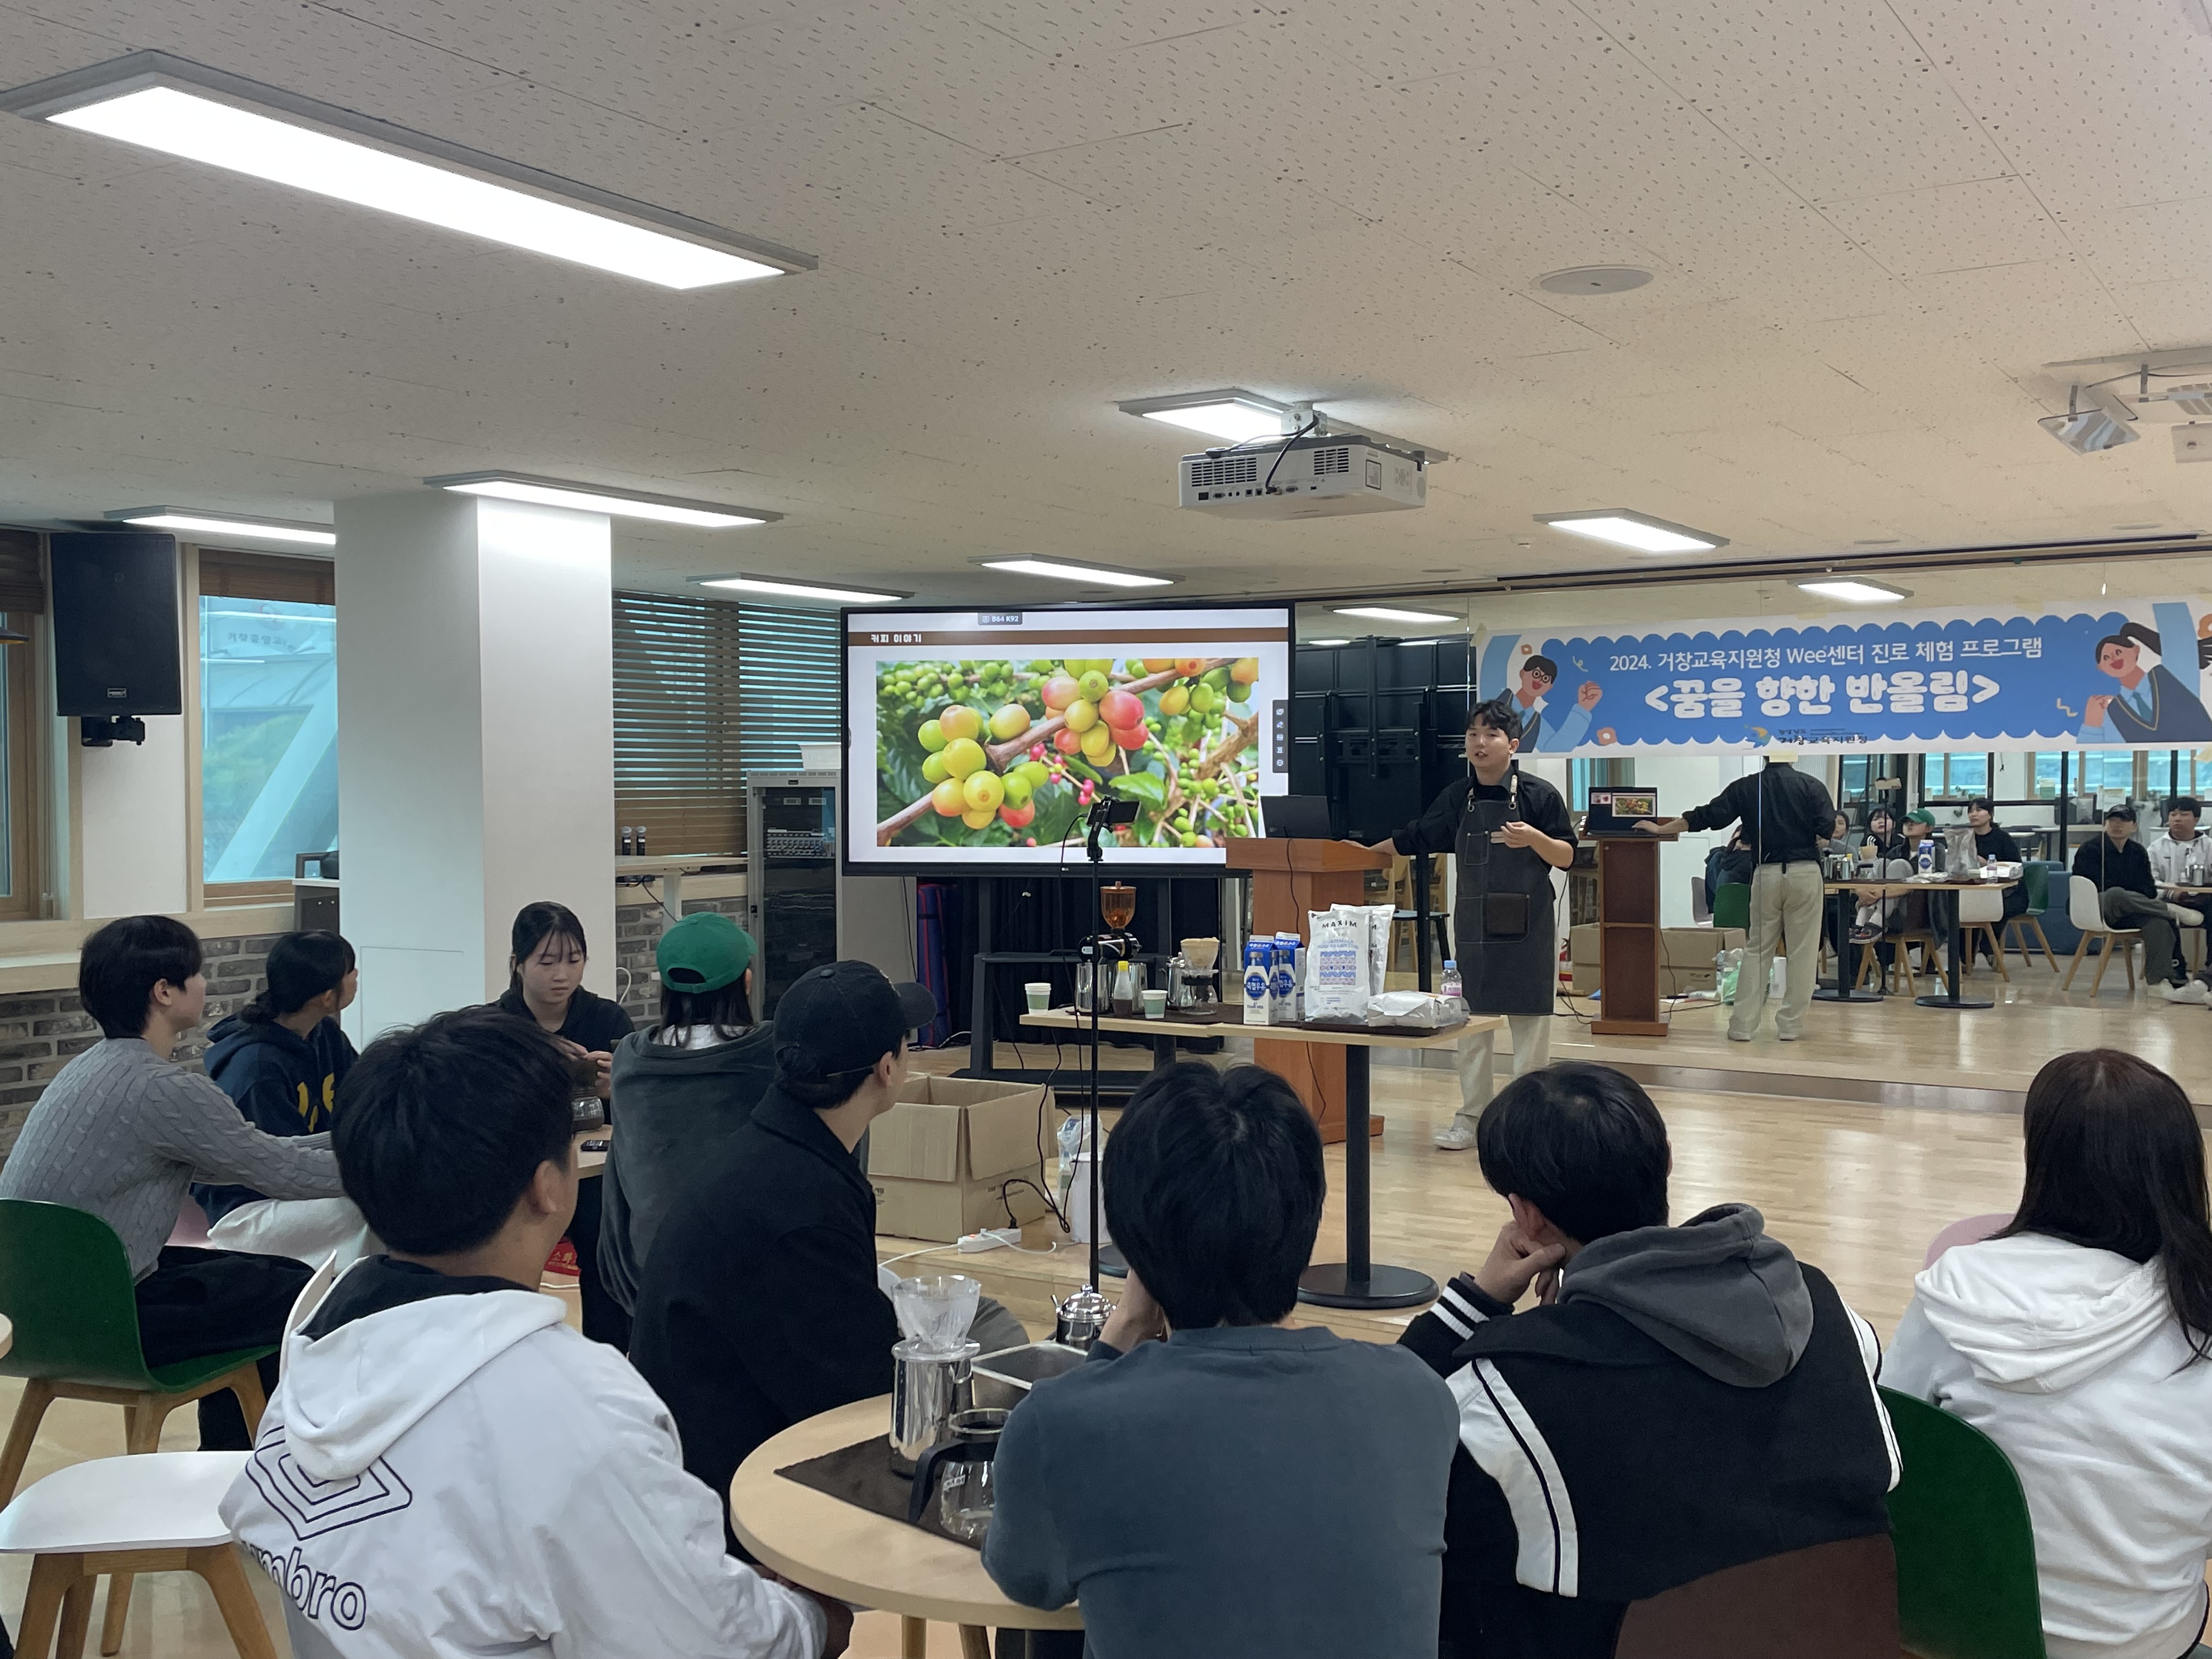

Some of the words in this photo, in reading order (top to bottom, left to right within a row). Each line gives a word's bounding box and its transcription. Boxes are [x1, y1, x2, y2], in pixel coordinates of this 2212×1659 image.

[871, 634, 889, 643] 커피
[893, 634, 922, 643] 이야기
[1609, 655, 1652, 672] 2024.
[1657, 648, 1781, 672] 거창교육지원청
[1787, 644, 1864, 665] Wee센터
[1871, 642, 1910, 664] 진로
[1915, 641, 1954, 662] 체험
[1960, 636, 2042, 658] 프로그램
[1645, 677, 1746, 719] <꿈을
[1756, 674, 1836, 717] 향한
[1846, 669, 2000, 714] 반올림>
[1322, 919, 1357, 929] MAXIM
[241, 1541, 366, 1631] mbro
